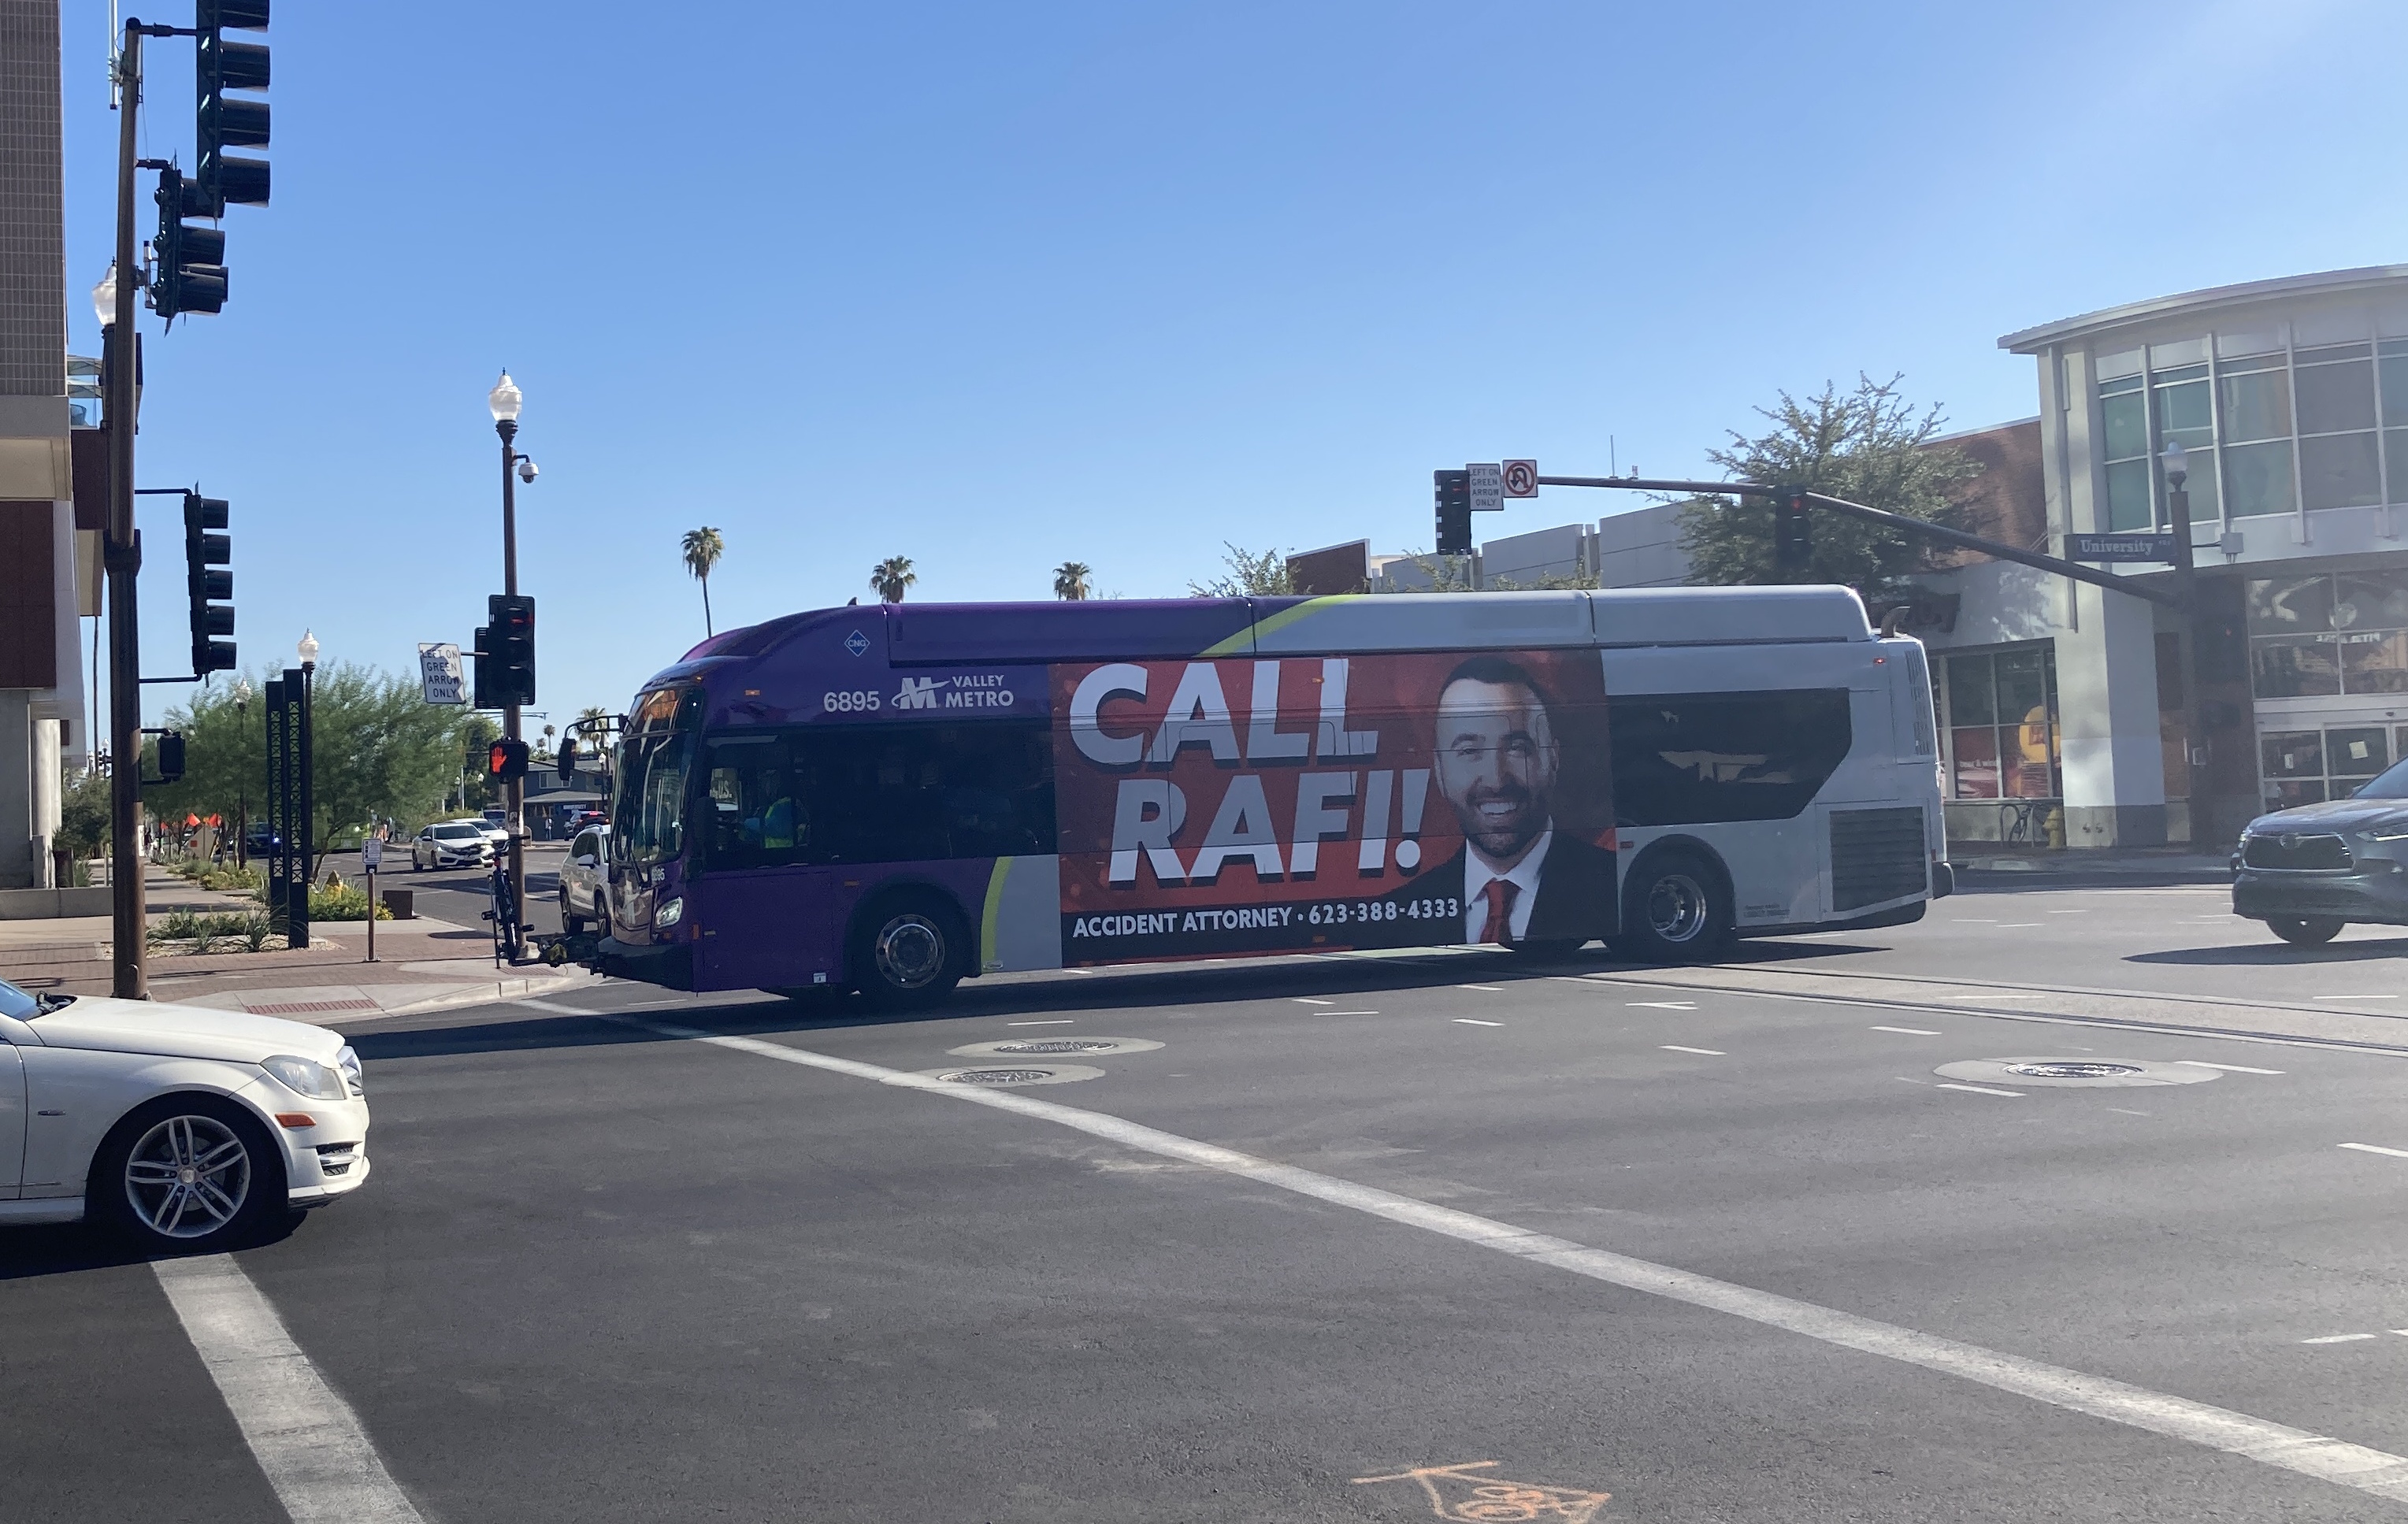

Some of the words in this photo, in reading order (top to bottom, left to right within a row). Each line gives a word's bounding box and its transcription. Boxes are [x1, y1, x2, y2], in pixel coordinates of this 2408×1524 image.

[2080, 539, 2154, 555] University
[446, 650, 458, 659] ON
[426, 662, 457, 672] GREEN
[428, 676, 459, 684] ARROW
[952, 675, 1004, 687] VALLEY
[432, 688, 457, 698] ONLY
[945, 690, 1014, 708] METRO
[824, 691, 880, 713] 6895
[1070, 658, 1378, 765] CALL
[1108, 769, 1430, 881] RAFI!
[1072, 913, 1177, 939] ACCIDENT
[1182, 907, 1292, 933] ATTORNEY
[1308, 898, 1458, 925] 623-388-4333
